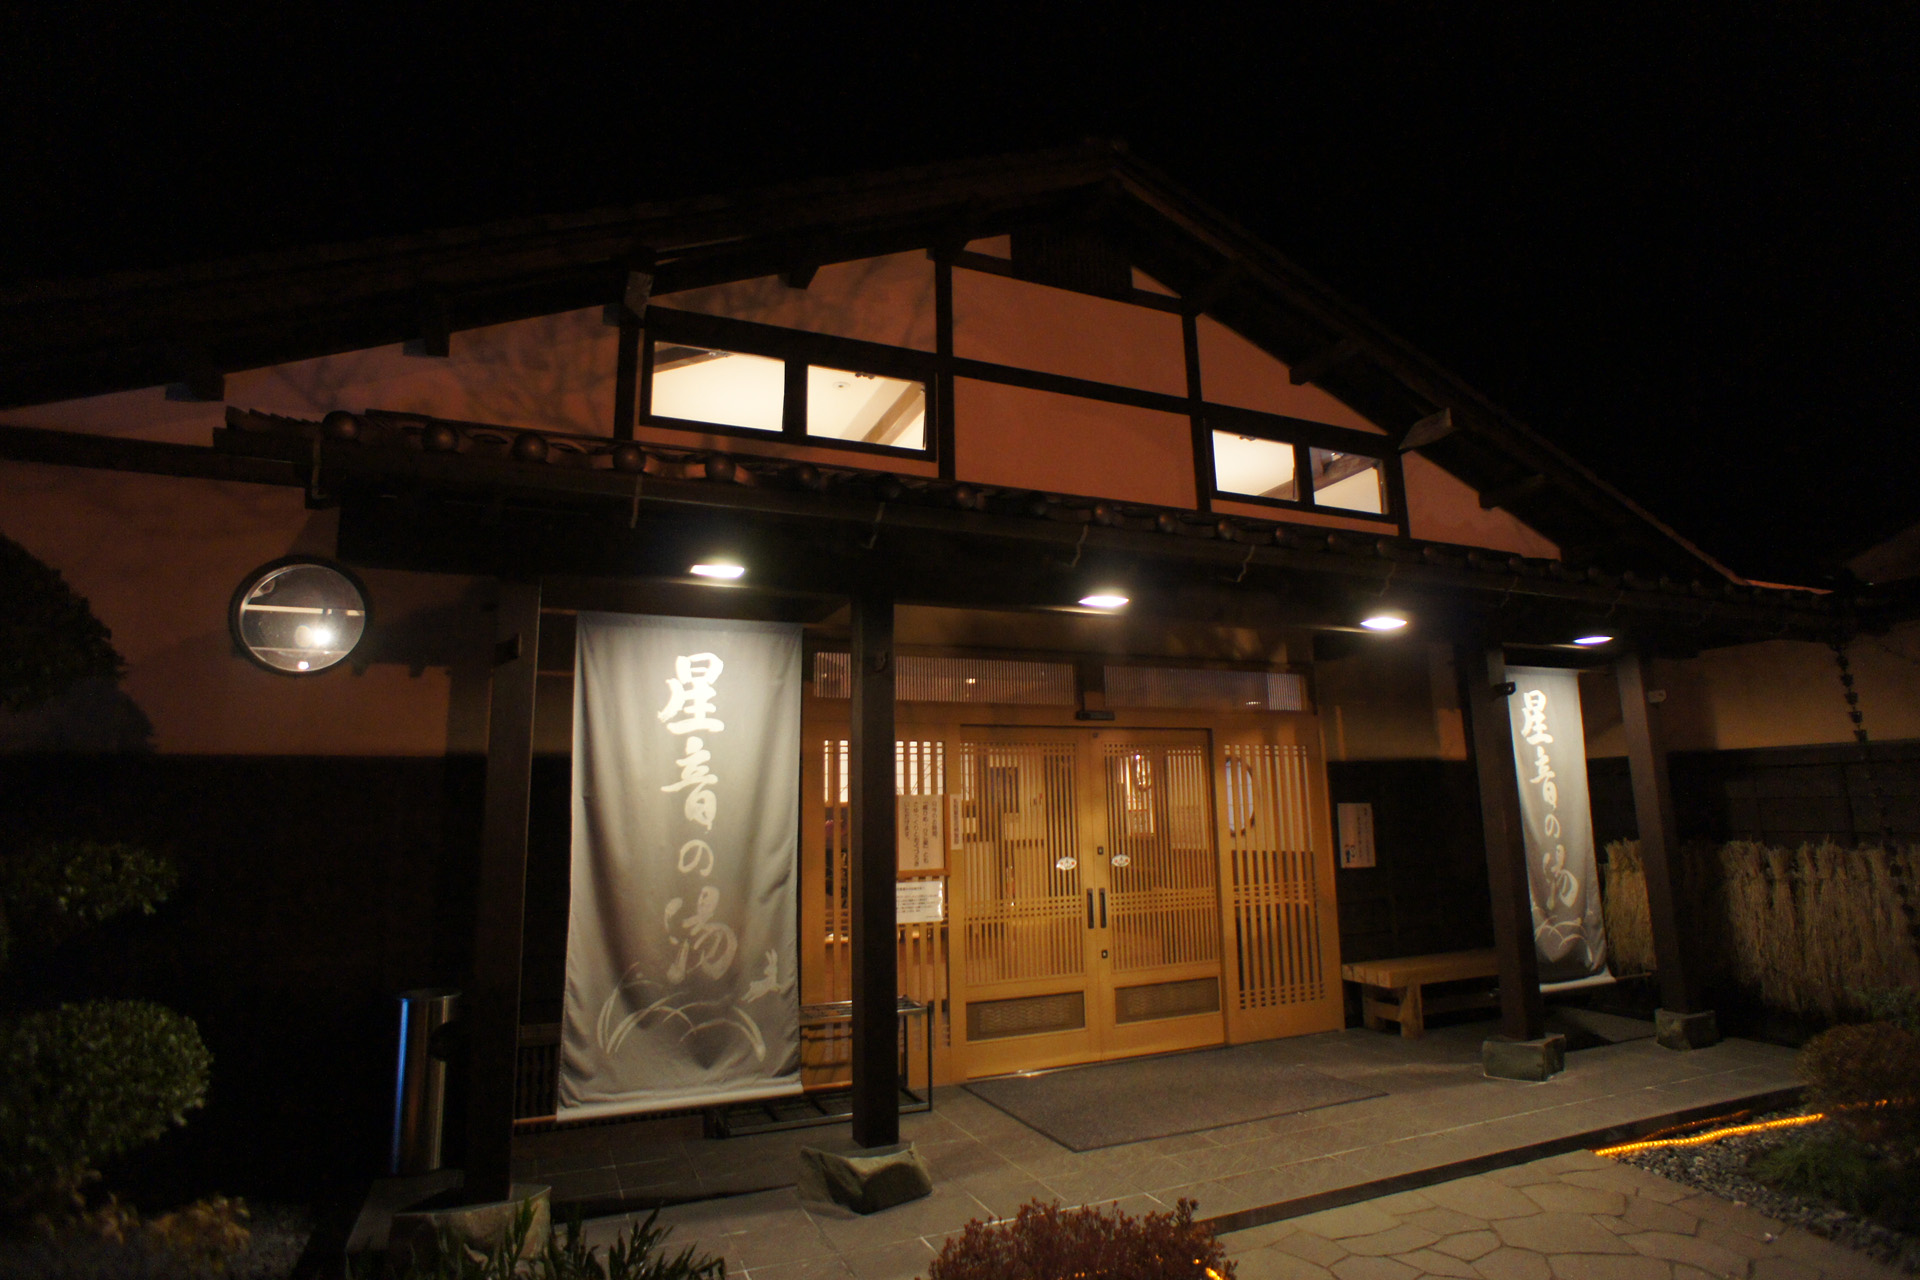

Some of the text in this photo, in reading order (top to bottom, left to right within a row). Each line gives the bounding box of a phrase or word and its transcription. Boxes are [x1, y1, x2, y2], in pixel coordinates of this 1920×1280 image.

[658, 652, 738, 985] 星音の湯
[1521, 689, 1579, 911] 星音の湯
